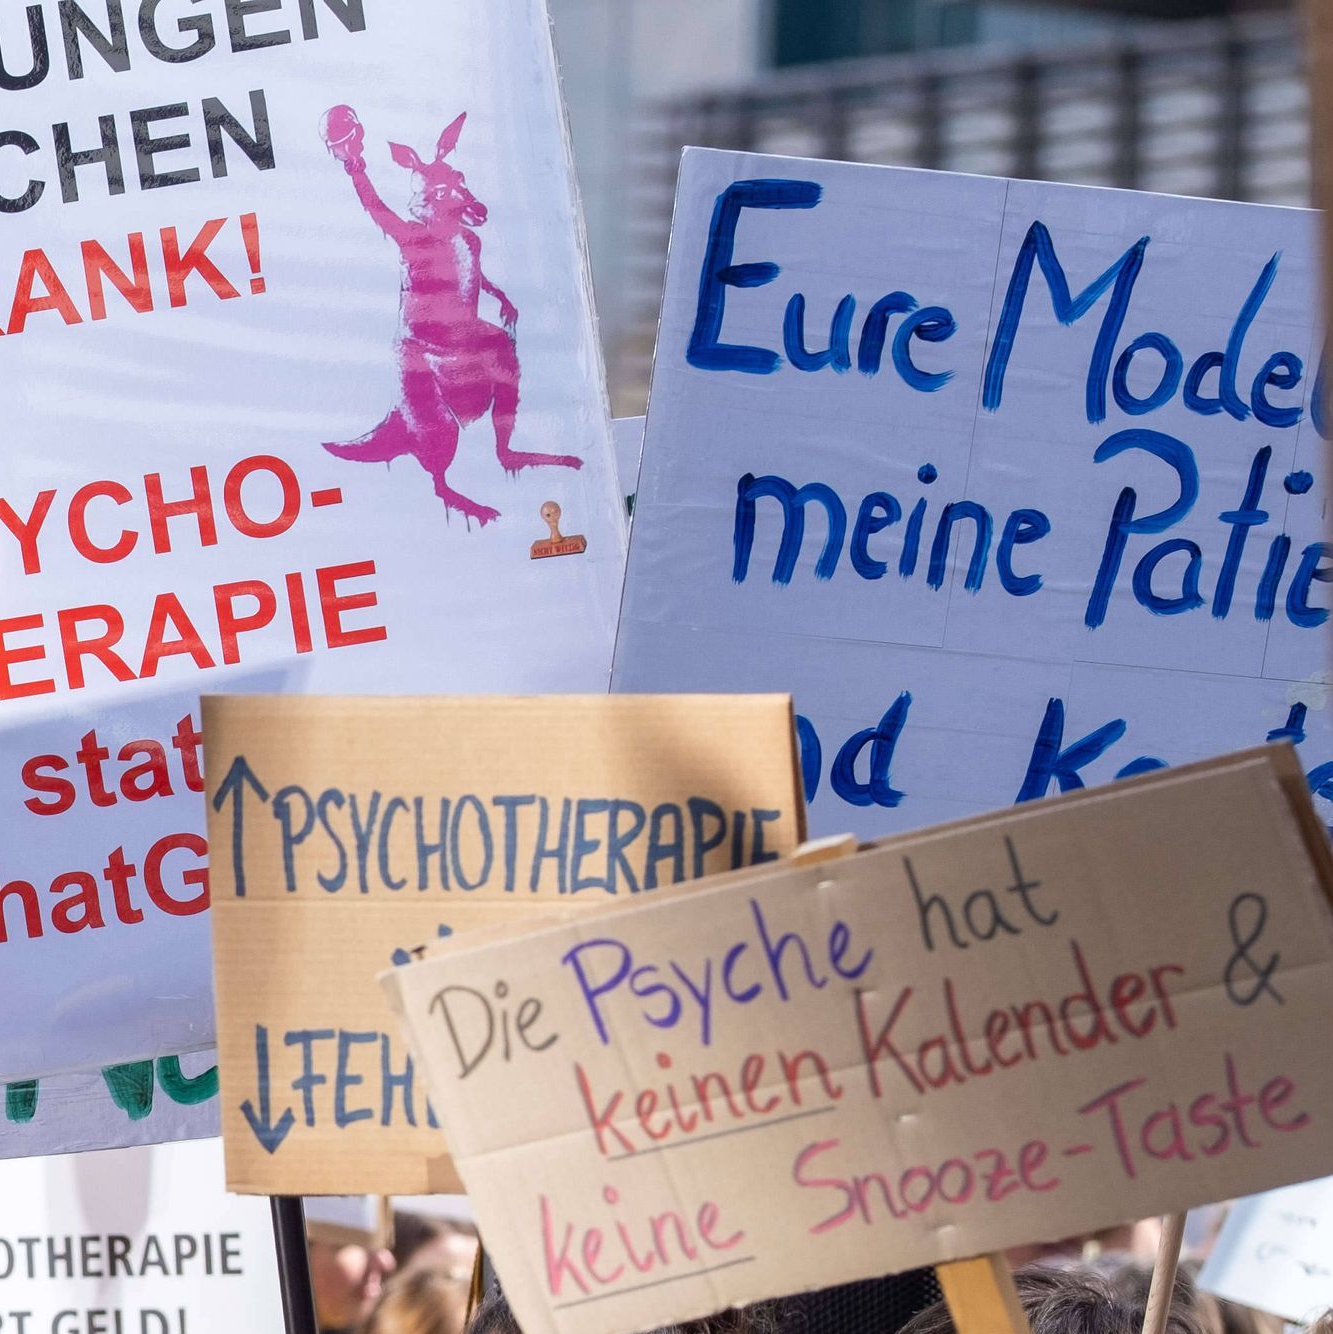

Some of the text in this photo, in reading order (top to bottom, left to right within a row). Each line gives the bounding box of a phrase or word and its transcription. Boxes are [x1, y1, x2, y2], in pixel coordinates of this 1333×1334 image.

[686, 178, 1333, 440] Eure Mode
[733, 462, 1052, 597] meine
[271, 783, 782, 895] PSYCHOTHERAPIE
[430, 835, 1058, 1080] Die Psyche hat
[577, 1043, 844, 1156] keinen
[853, 940, 1186, 1098] Kalender
[284, 1028, 440, 1128] FEH
[540, 1053, 1311, 1297] keine Snooze-Taste
